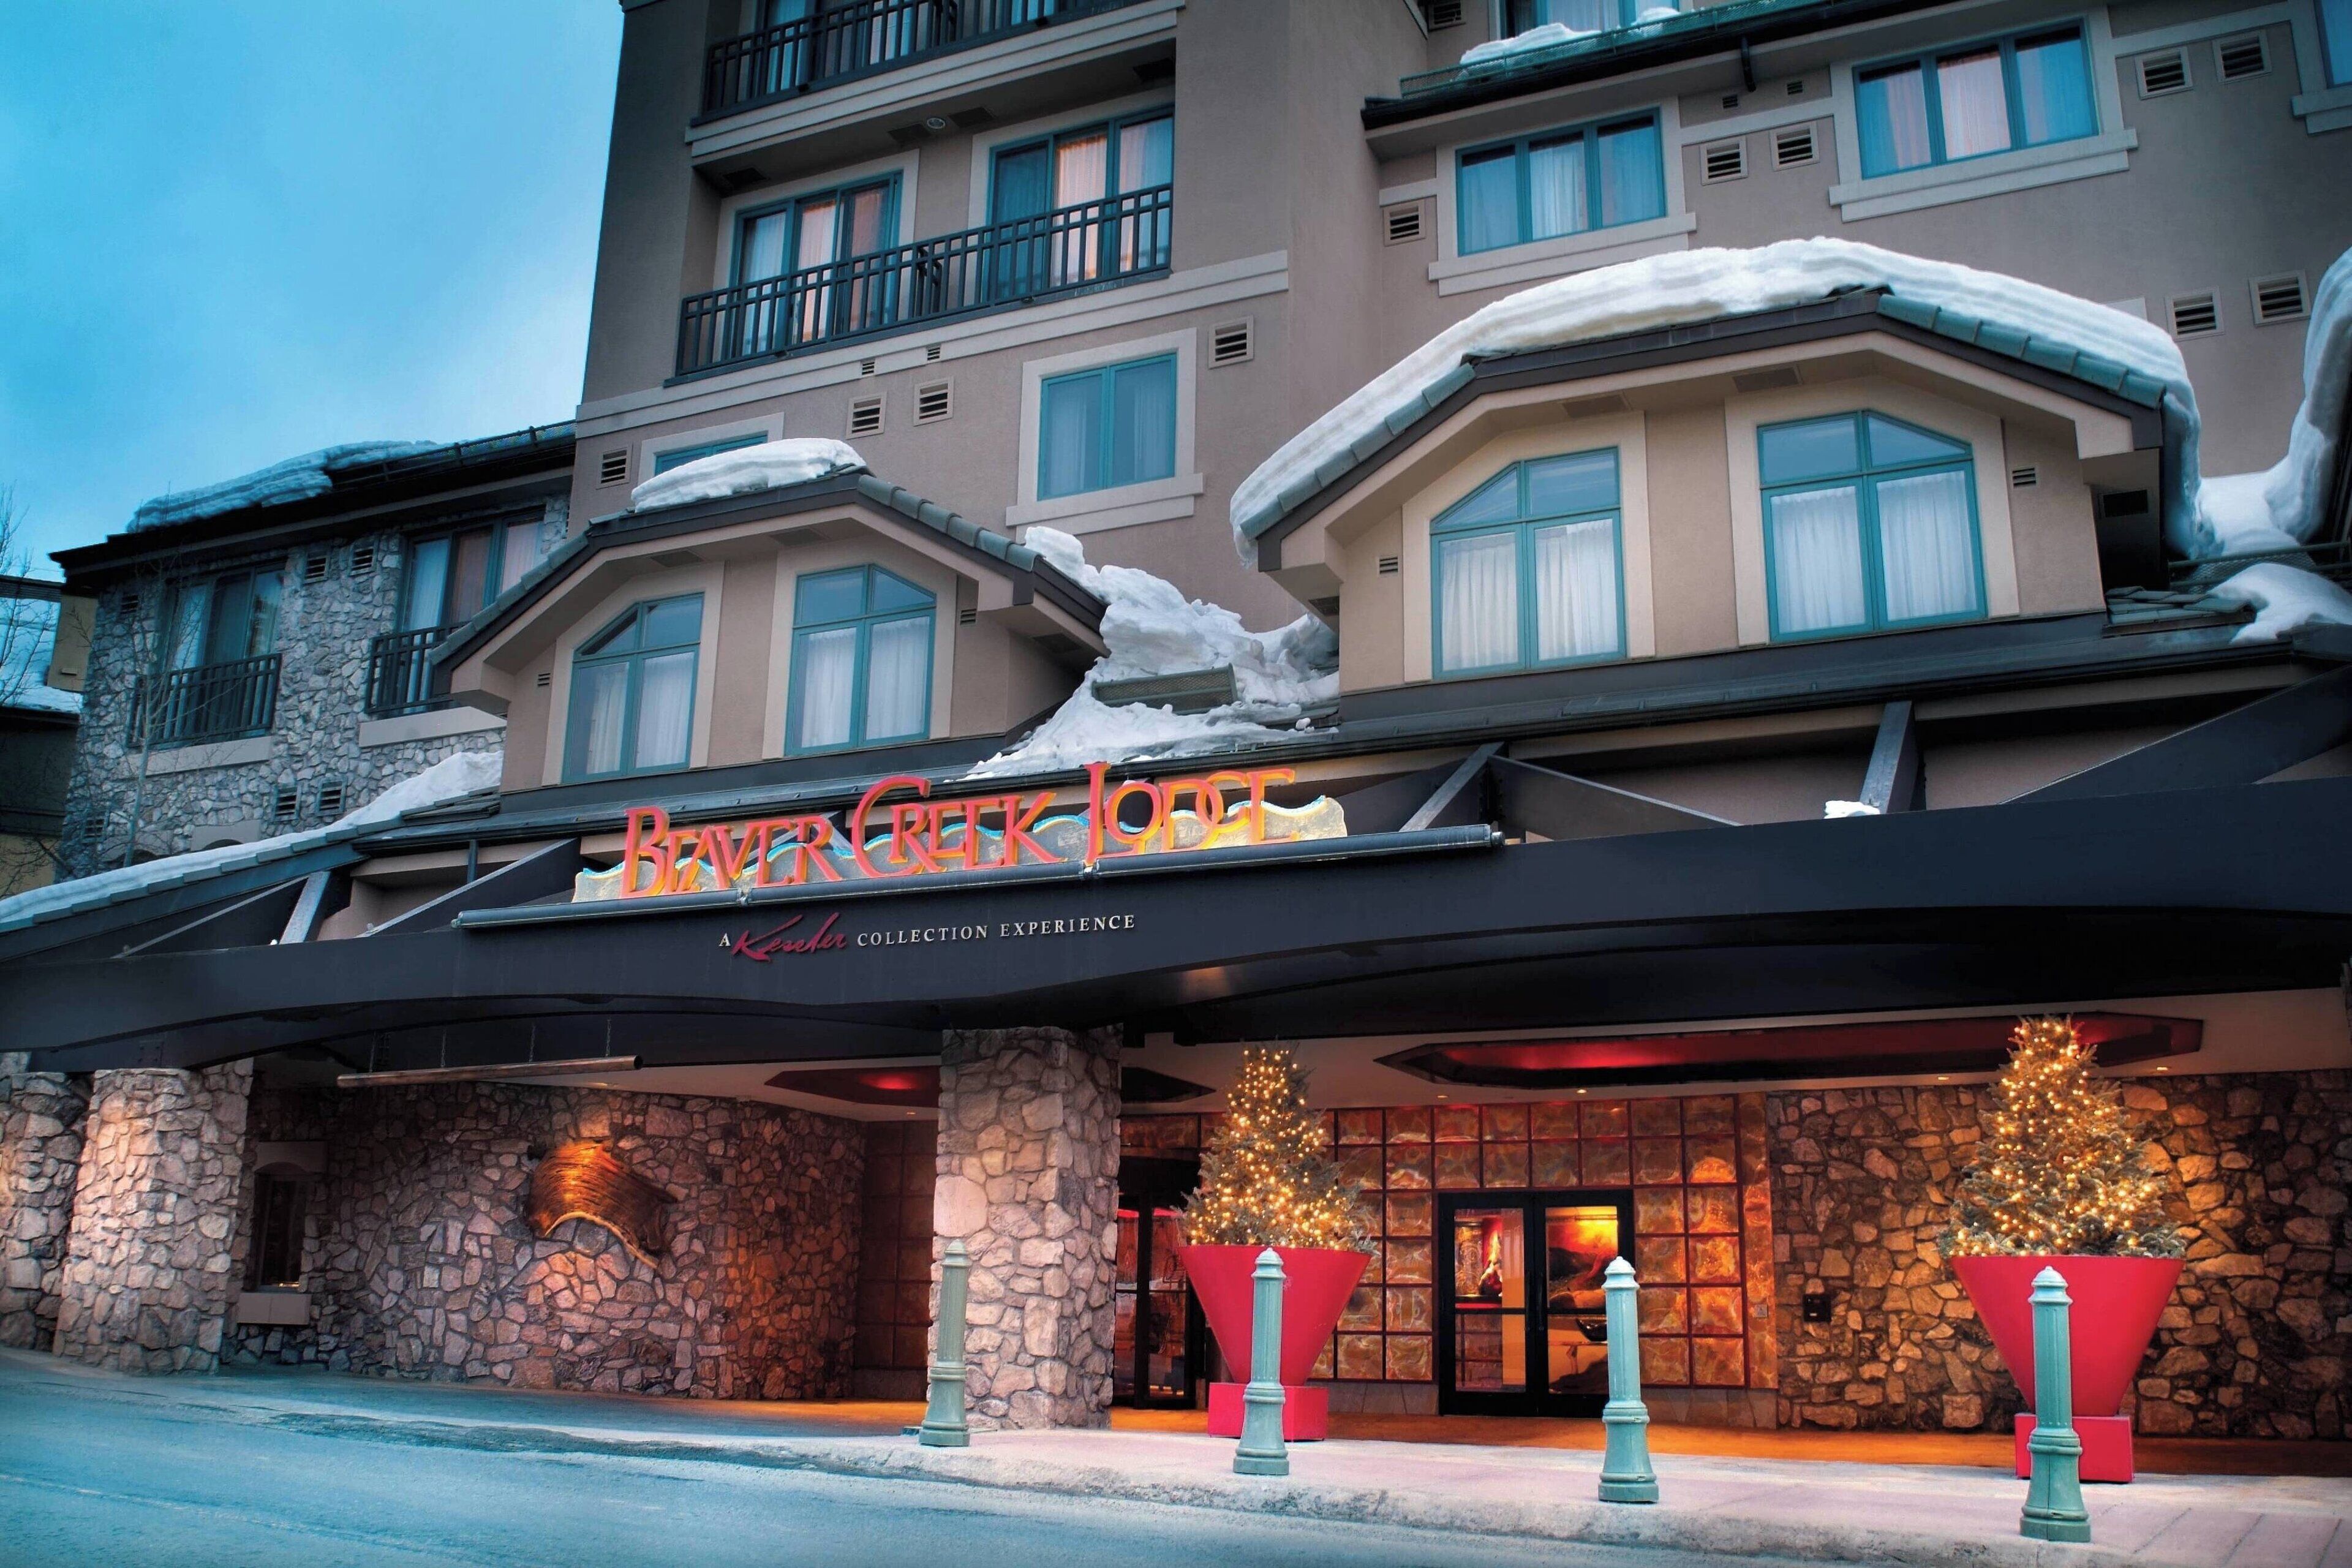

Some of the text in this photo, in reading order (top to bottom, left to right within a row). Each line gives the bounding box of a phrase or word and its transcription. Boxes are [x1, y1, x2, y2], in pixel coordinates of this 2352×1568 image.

[621, 761, 1298, 899] BEAVER CREEK LODGE
[718, 933, 731, 947] A
[858, 925, 987, 946] COLLECTION
[1000, 914, 1134, 937] EXPERIENCE
